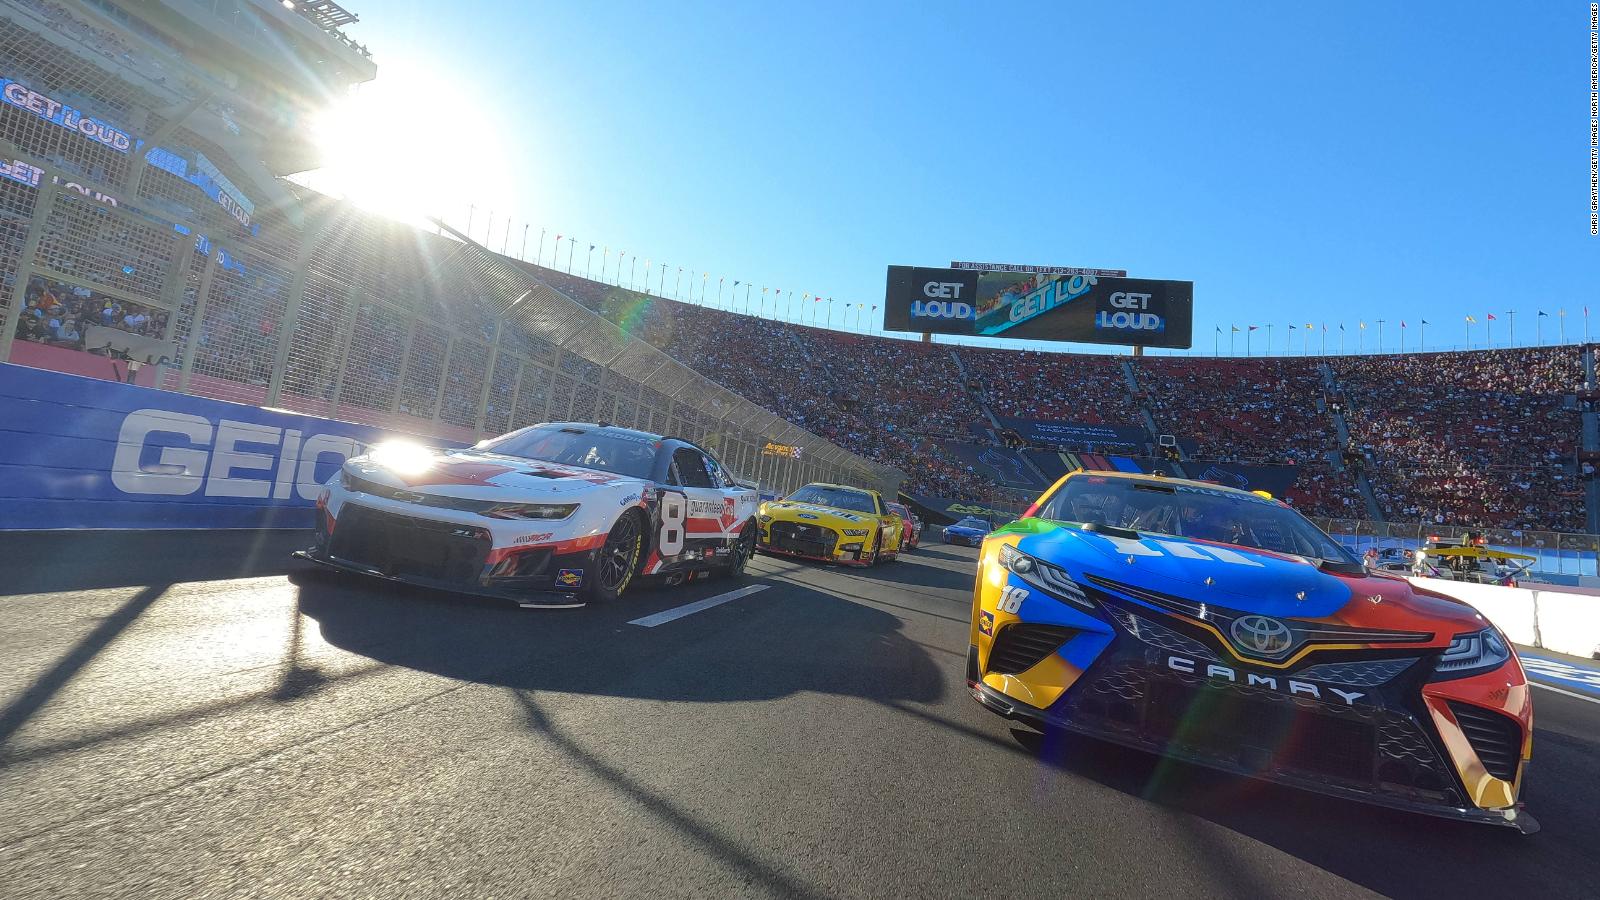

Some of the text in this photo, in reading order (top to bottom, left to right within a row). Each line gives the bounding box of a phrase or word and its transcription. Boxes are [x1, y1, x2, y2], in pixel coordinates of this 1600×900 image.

[4, 81, 130, 151] GET LOUD
[218, 190, 232, 211] GET
[958, 262, 970, 270] FOR
[970, 262, 1007, 272] ASSISTANCE
[1008, 264, 1024, 272] CALL
[1035, 266, 1050, 274] TEXT
[923, 281, 965, 299] GET
[1009, 284, 1052, 322] GET
[1109, 291, 1152, 310] GET
[914, 300, 972, 320] LOUD
[1101, 311, 1160, 331] LOUD
[111, 408, 366, 500] GEICO
[660, 490, 687, 556] 8
[996, 584, 1030, 615] 18
[1168, 656, 1366, 705] CAMRY
